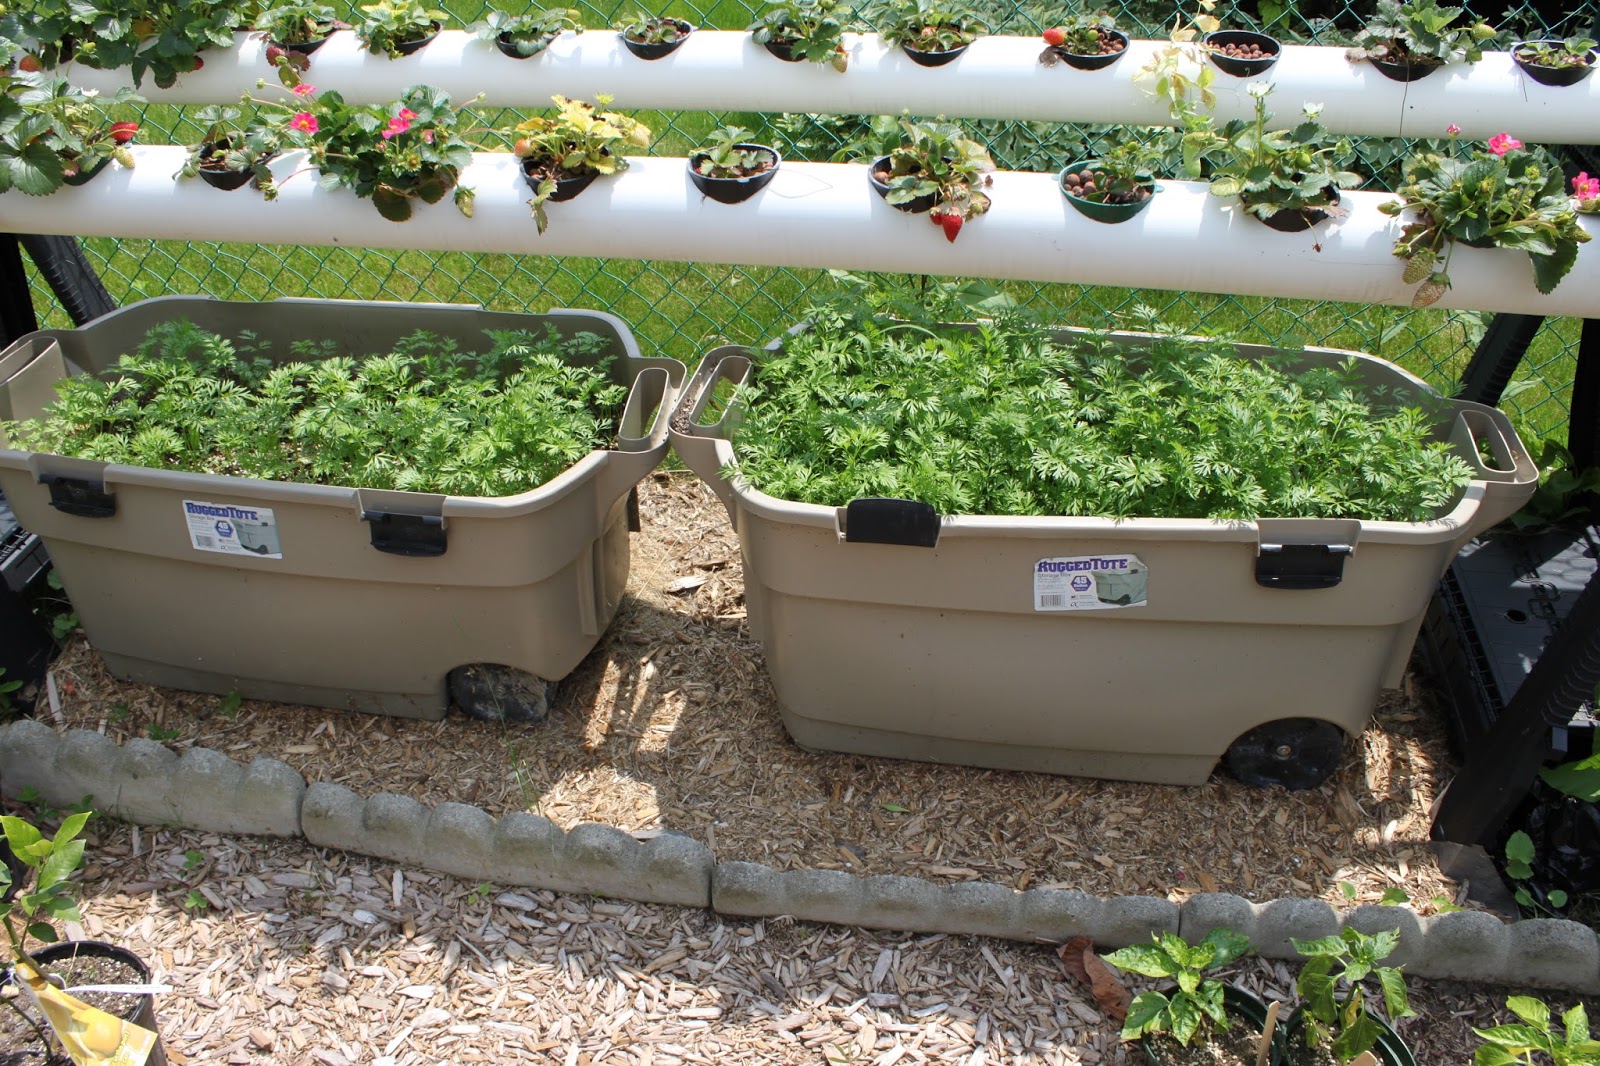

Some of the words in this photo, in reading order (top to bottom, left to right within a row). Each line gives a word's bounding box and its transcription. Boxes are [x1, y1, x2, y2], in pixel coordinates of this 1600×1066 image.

[185, 502, 258, 520] RUGGEDTOTE
[217, 521, 229, 530] 45
[1038, 558, 1128, 572] RUGGEDTOTE
[1074, 576, 1088, 584] 45
